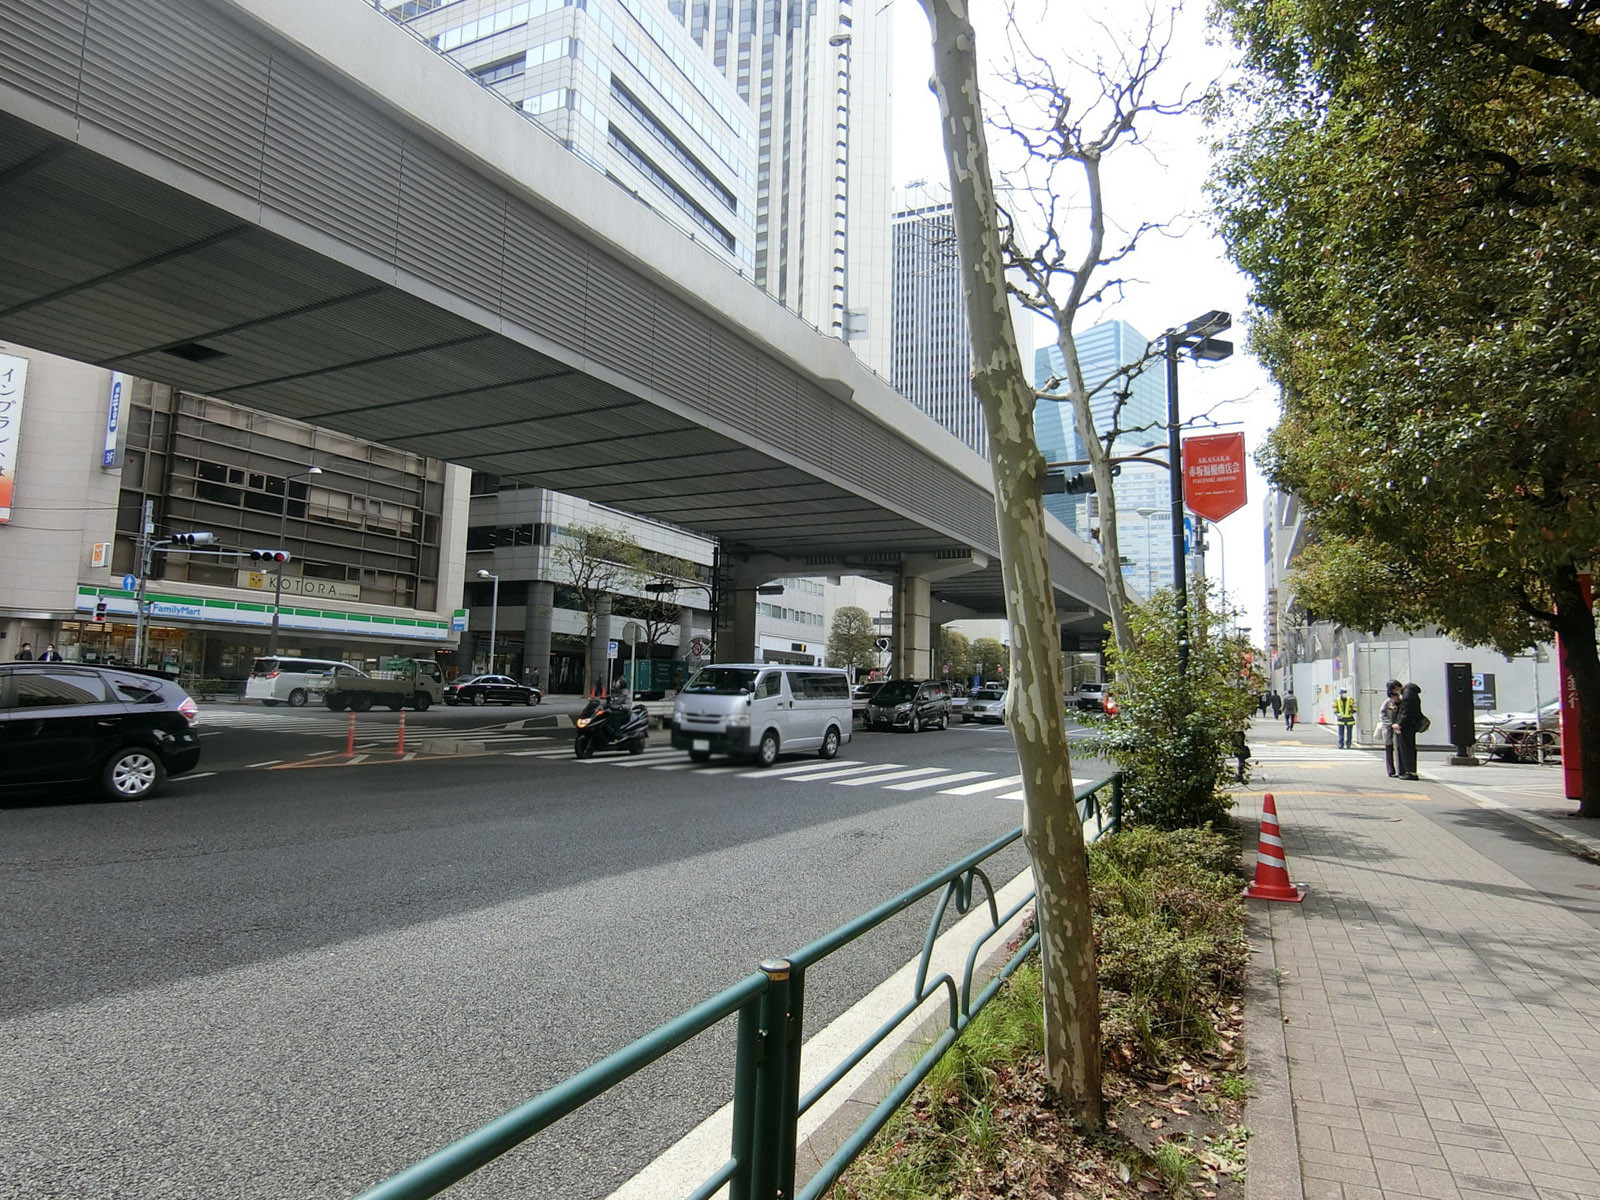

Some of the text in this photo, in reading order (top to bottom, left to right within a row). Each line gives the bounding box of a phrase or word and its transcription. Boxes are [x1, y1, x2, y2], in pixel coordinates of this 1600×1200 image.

[0, 368, 16, 477] インプラ
[1198, 455, 1230, 464] AKASAKA
[269, 577, 336, 595] KOTORA
[153, 603, 201, 615] FamilyMart
[609, 643, 617, 651] P
